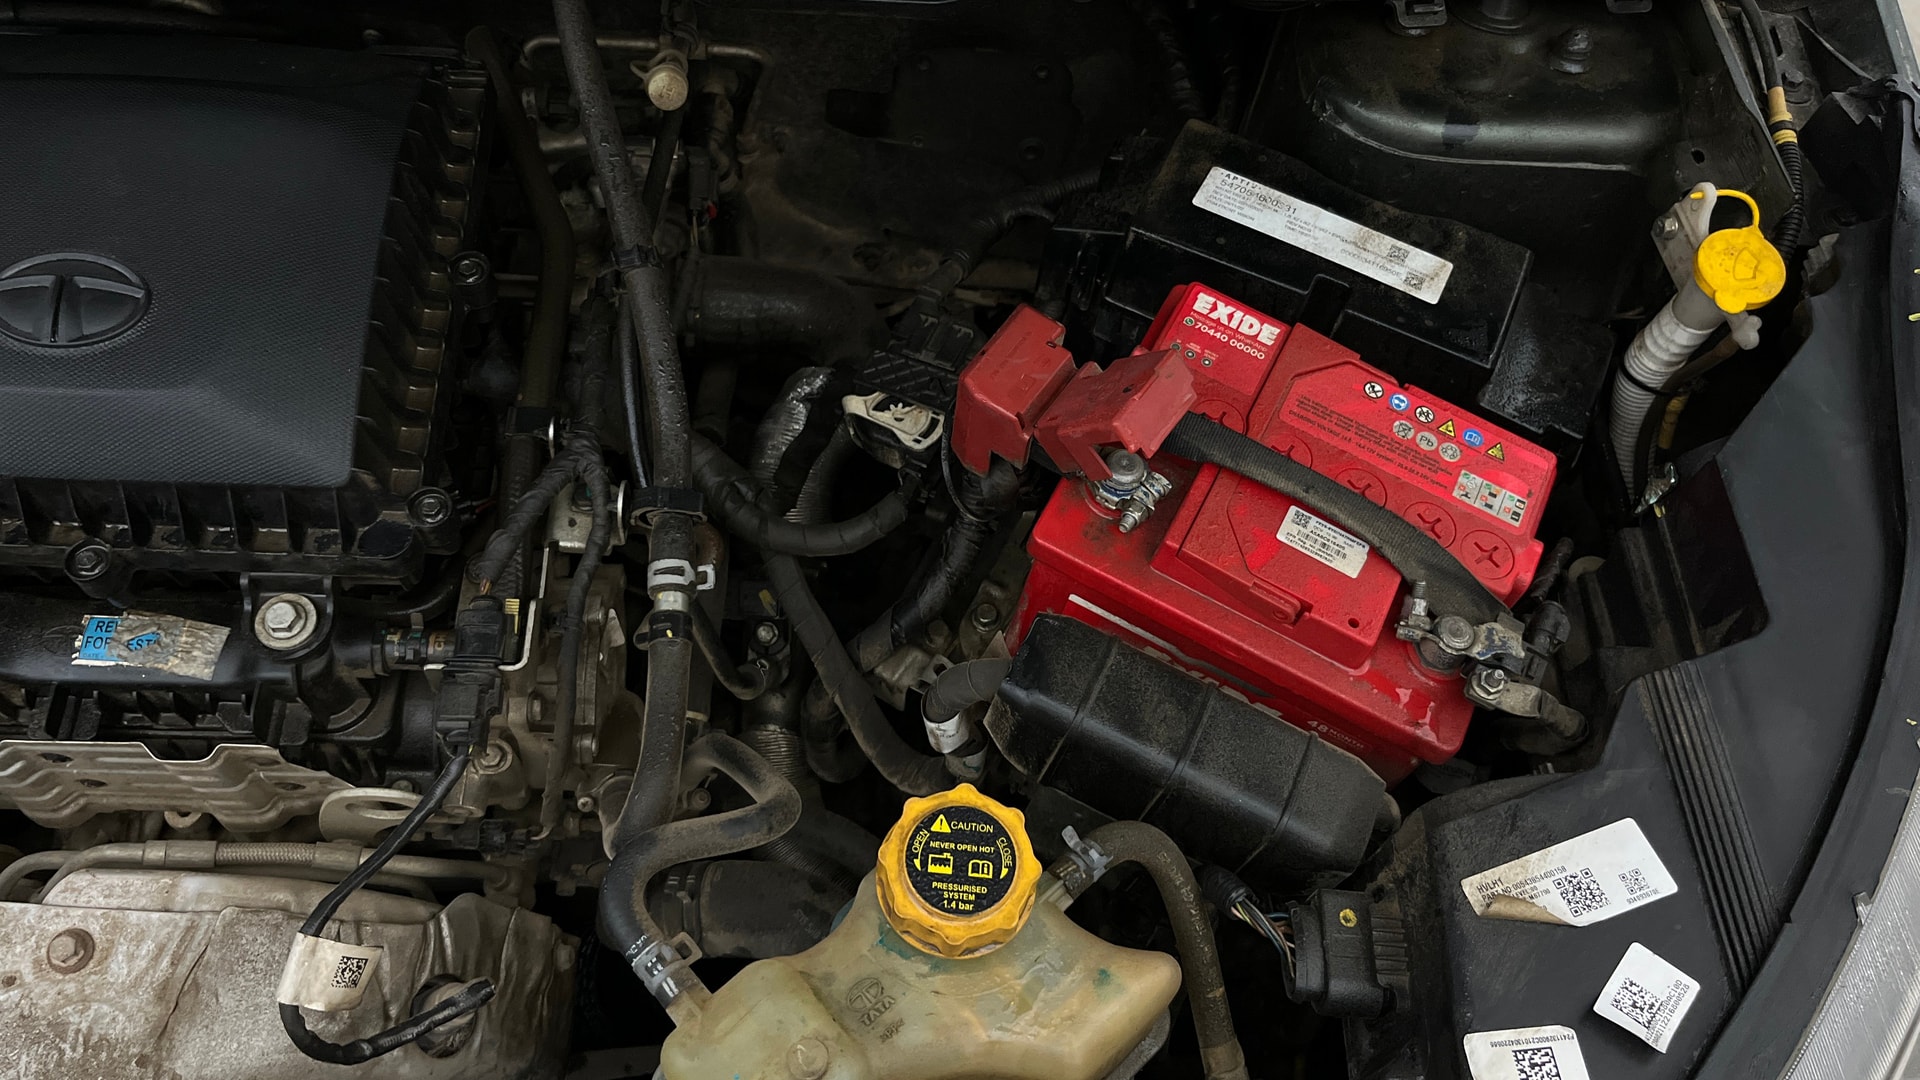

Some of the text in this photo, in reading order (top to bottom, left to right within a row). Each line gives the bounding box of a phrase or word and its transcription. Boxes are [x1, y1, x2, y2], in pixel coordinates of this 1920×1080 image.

[1192, 292, 1280, 345] EXIDE
[1195, 322, 1228, 343] 70440
[1230, 339, 1265, 360] 00000
[1420, 435, 1434, 448] Pb
[95, 621, 118, 633] RE
[951, 821, 993, 832] CAUTION
[912, 829, 929, 853] OPEN
[930, 840, 995, 853] NEVER OPEN HOT
[998, 836, 1013, 868] CLOSE
[932, 882, 988, 894] PRESSURISED
[1476, 878, 1504, 893] HVLH1
[943, 892, 975, 901] SYSTEM
[943, 900, 974, 911] 1.4 bar
[861, 995, 897, 1028] TATA
